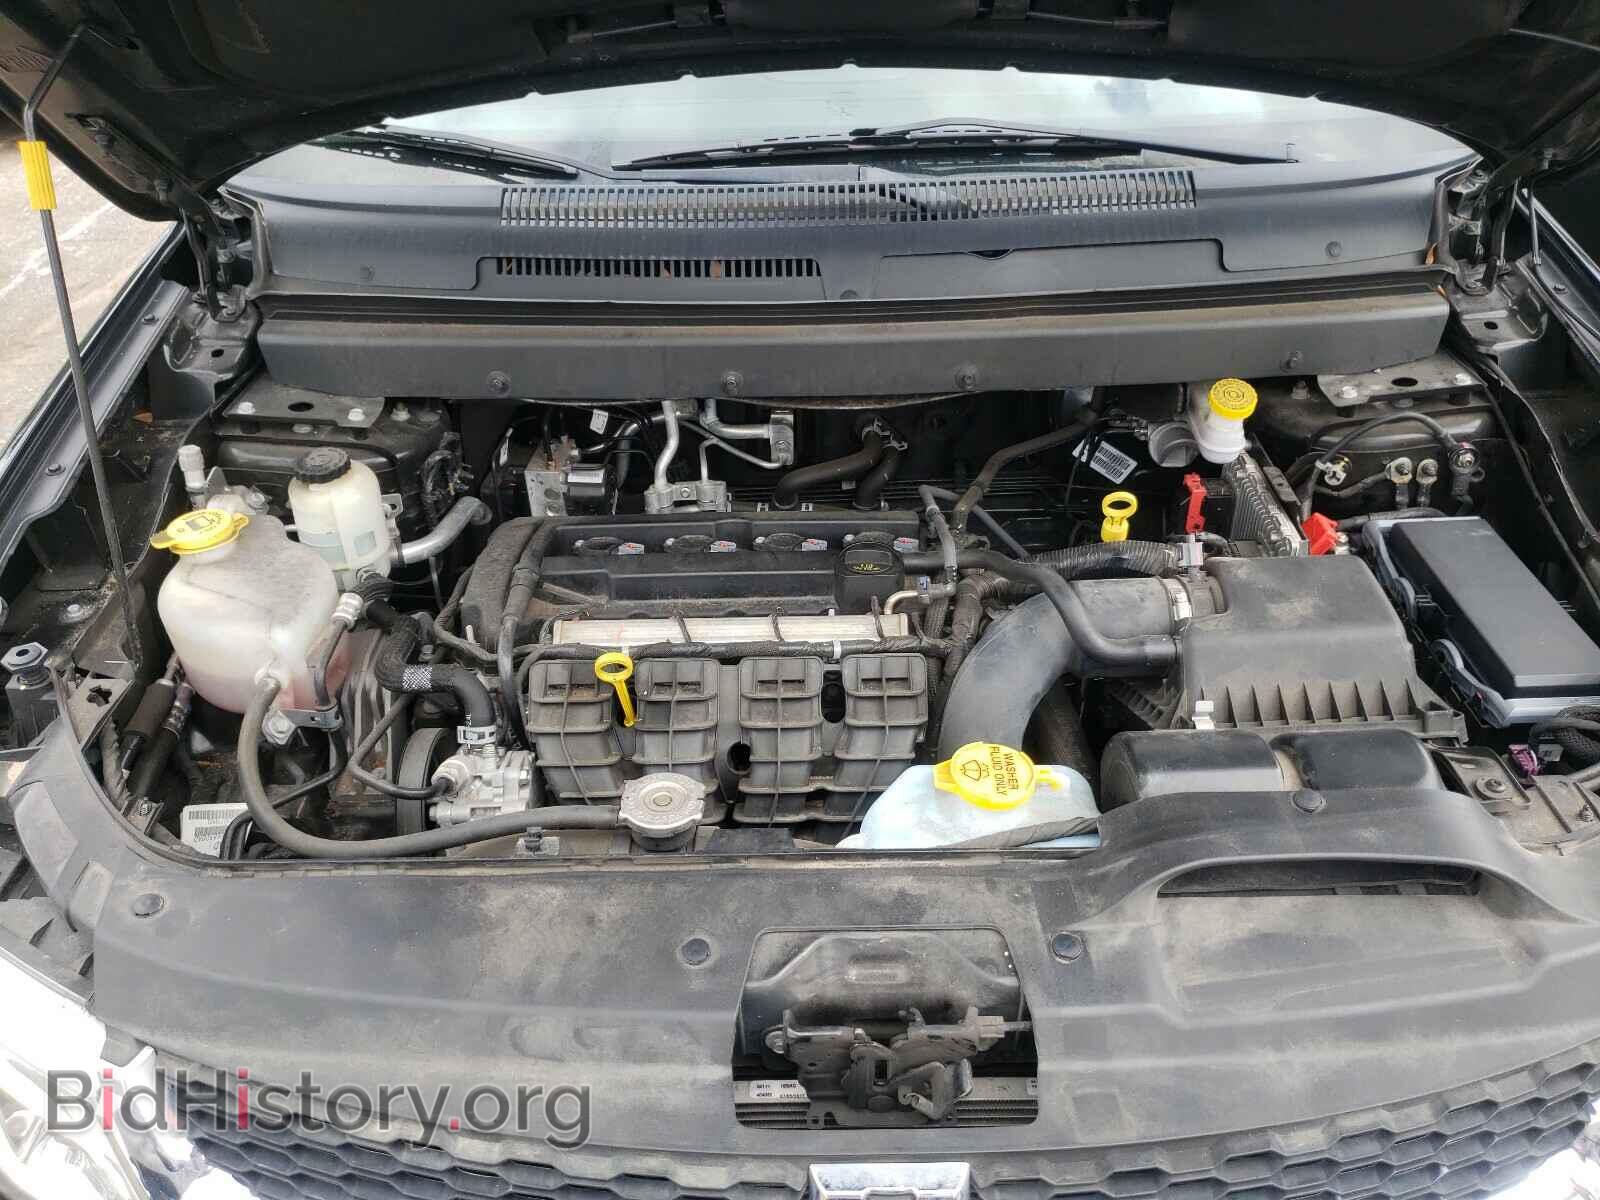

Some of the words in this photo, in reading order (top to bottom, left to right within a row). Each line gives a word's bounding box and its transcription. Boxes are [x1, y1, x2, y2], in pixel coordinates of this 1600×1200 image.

[990, 746, 1003, 771] FLUID
[1003, 752, 1019, 790] WASHER
[994, 773, 1008, 796] ONLY
